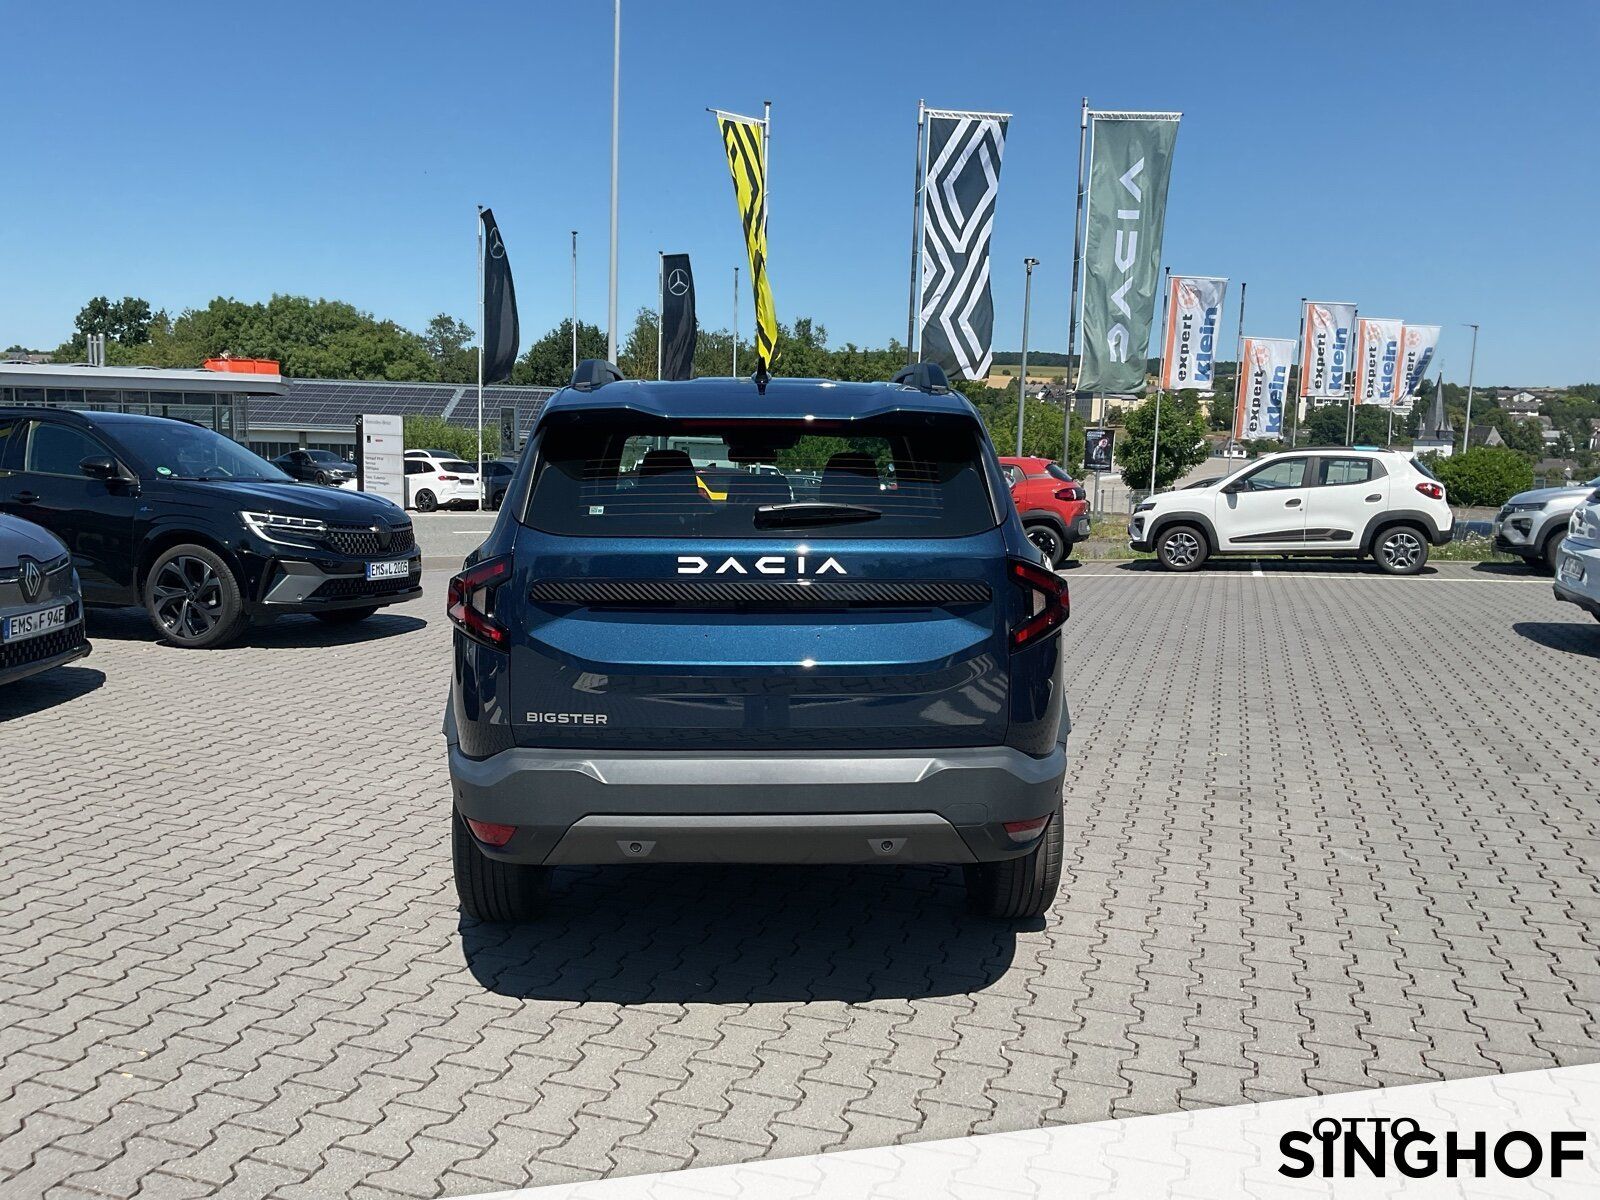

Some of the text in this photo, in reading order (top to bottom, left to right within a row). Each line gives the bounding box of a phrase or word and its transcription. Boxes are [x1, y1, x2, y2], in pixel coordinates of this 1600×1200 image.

[1107, 157, 1145, 364] DACIA
[1178, 314, 1193, 382] expert
[1194, 306, 1218, 382] klein
[1314, 333, 1326, 389] expert
[1329, 327, 1348, 390] klein
[1366, 346, 1377, 398] expert
[1379, 341, 1397, 398] klein
[1249, 369, 1264, 432] expert
[1265, 365, 1287, 433] klein
[371, 563, 385, 576] EMS
[677, 556, 847, 574] DACIA
[11, 608, 65, 635] EMS F 94E
[526, 711, 608, 725] BIGSTER
